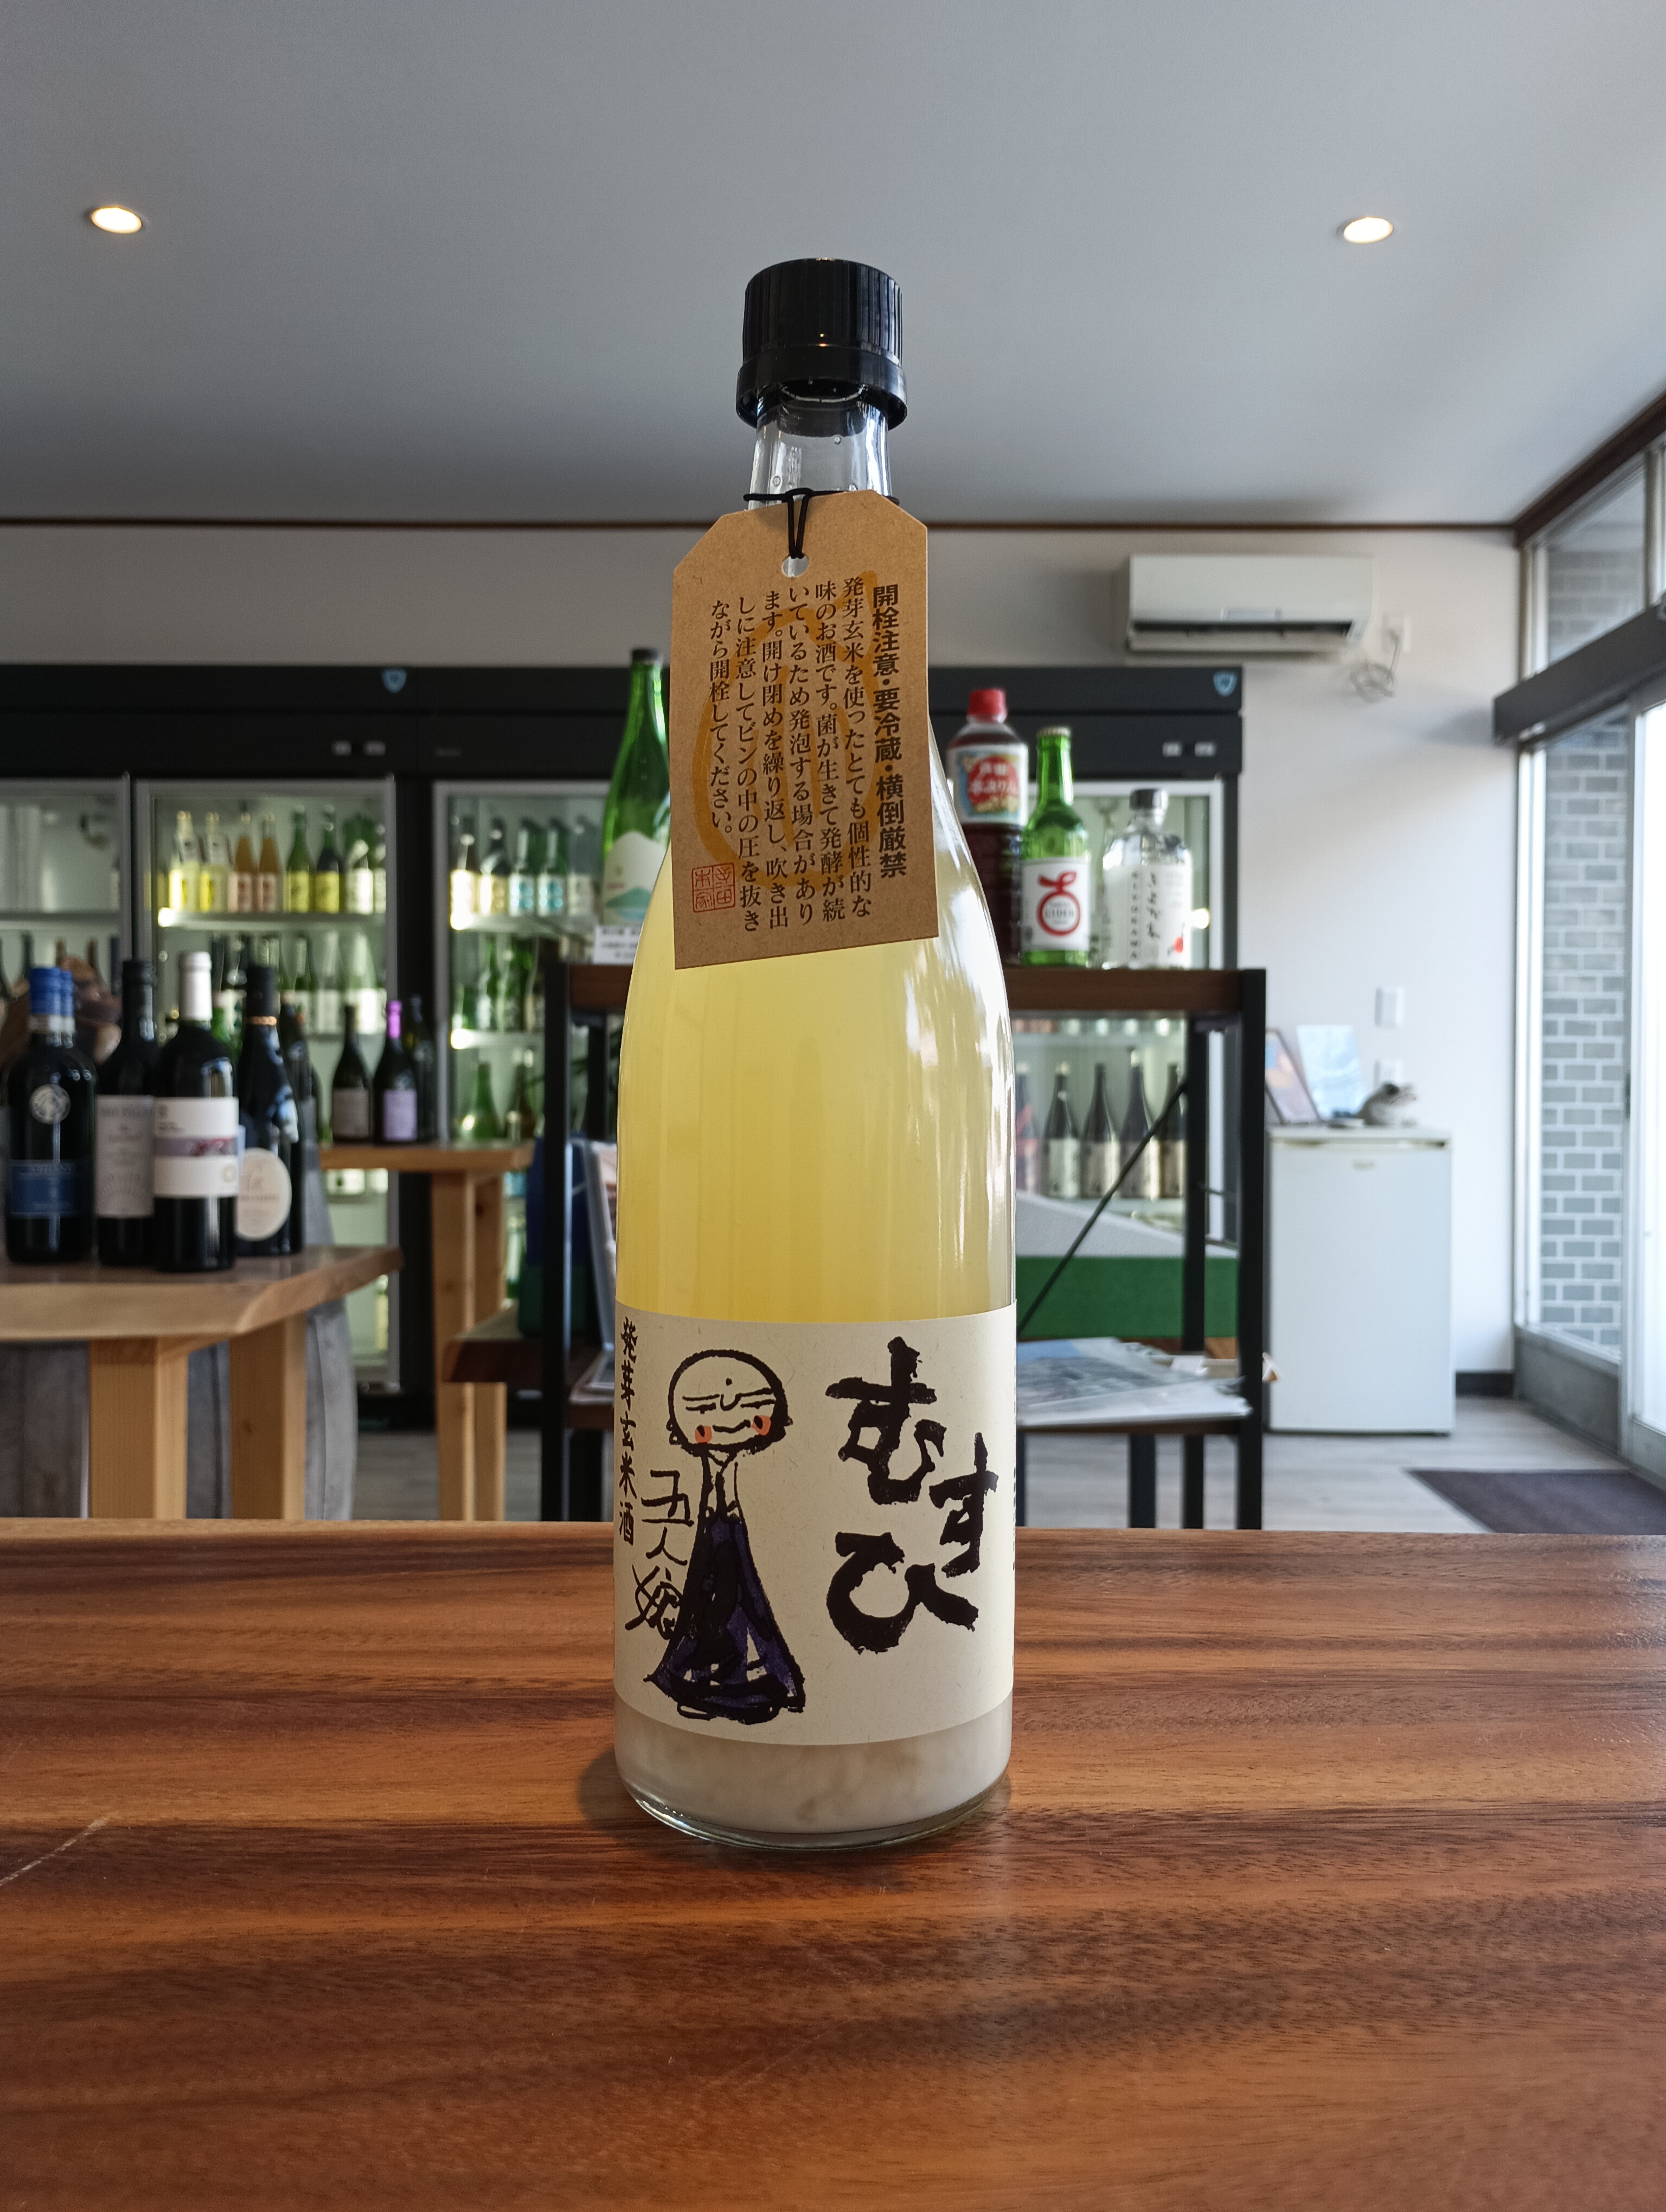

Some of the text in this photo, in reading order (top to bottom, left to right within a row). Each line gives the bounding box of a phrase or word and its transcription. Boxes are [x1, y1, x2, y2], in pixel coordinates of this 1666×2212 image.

[709, 601, 732, 834] ながら開栓してください。
[735, 597, 761, 932] しに注意してビンの中の圧を抜き
[761, 591, 789, 929] ます。開け閉めを繰り返し、吹き出
[789, 587, 815, 925] いているため発泡する場合があり
[815, 581, 845, 922] 味のお酒です。菌が生きて発酵が続
[842, 576, 872, 917] 発芽玄米を使ったとても個性的な
